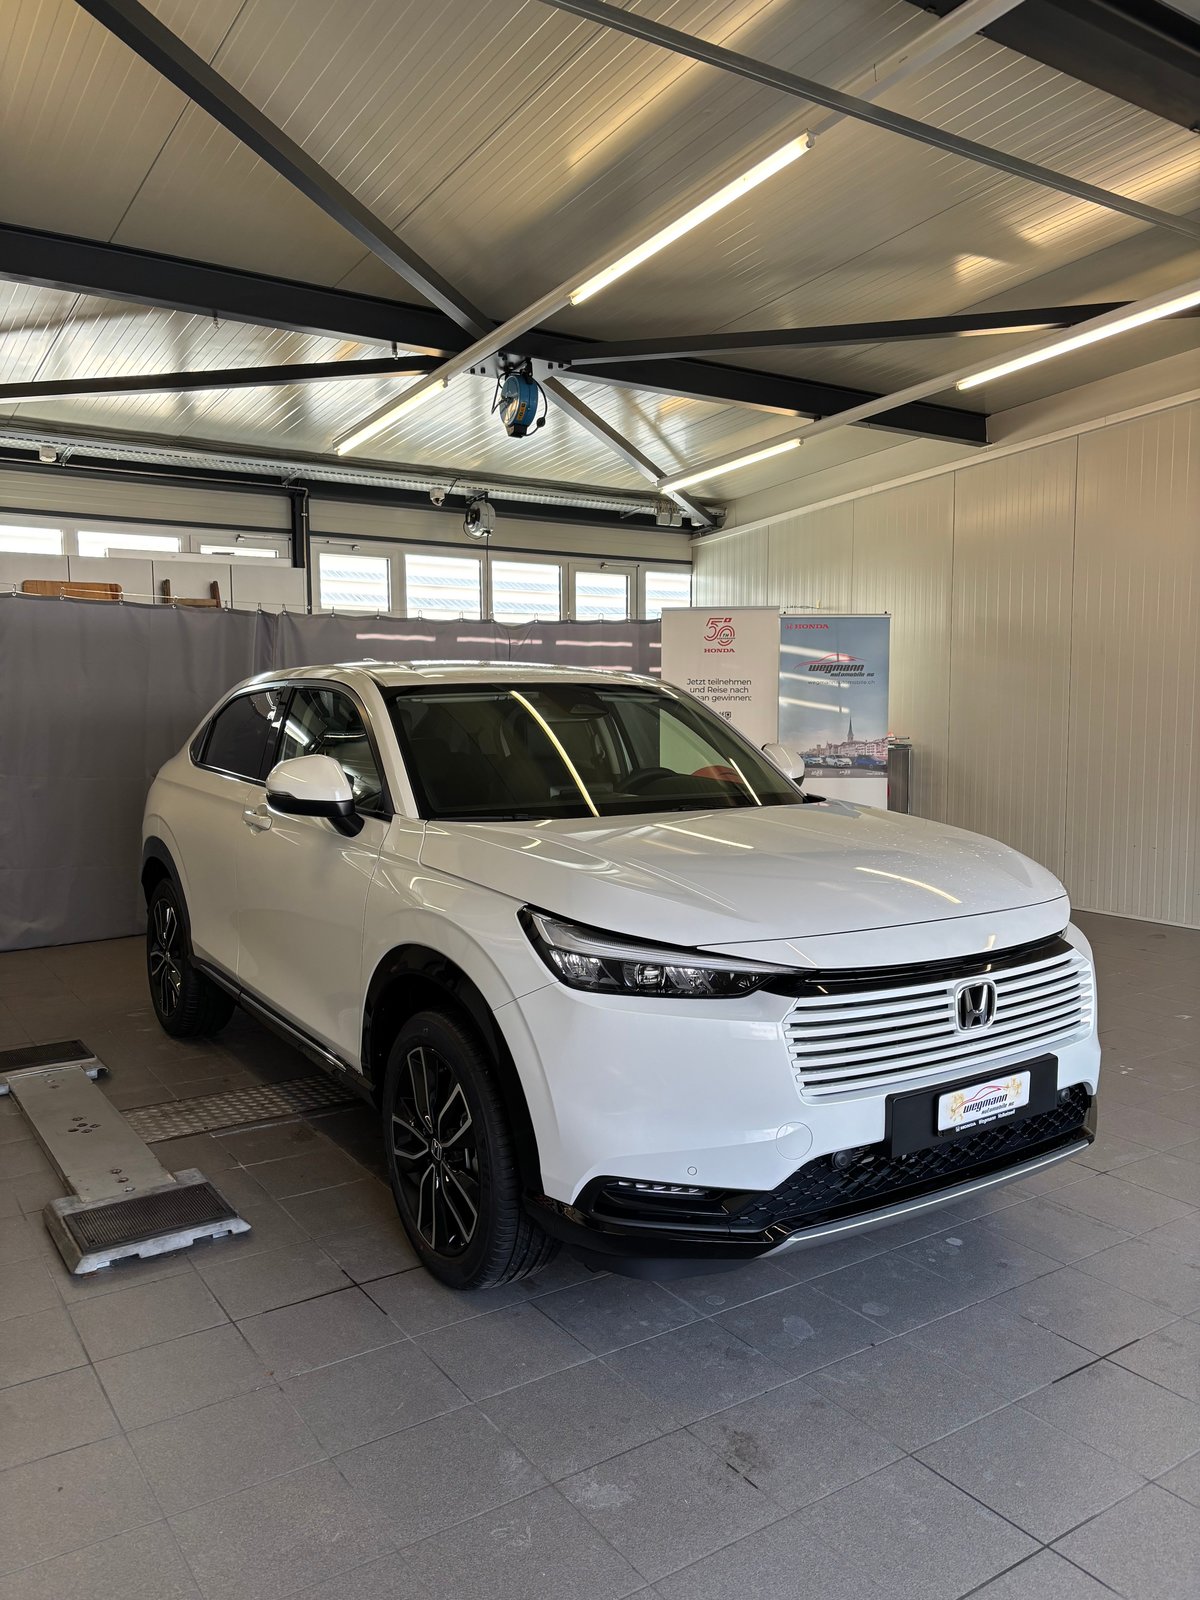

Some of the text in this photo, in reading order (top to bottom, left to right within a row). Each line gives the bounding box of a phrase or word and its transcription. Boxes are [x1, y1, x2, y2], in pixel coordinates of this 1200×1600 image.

[704, 617, 735, 647] 50
[808, 664, 865, 674] wegmann
[711, 694, 752, 702] gewinnen:
[963, 1093, 1008, 1113] wegmann
